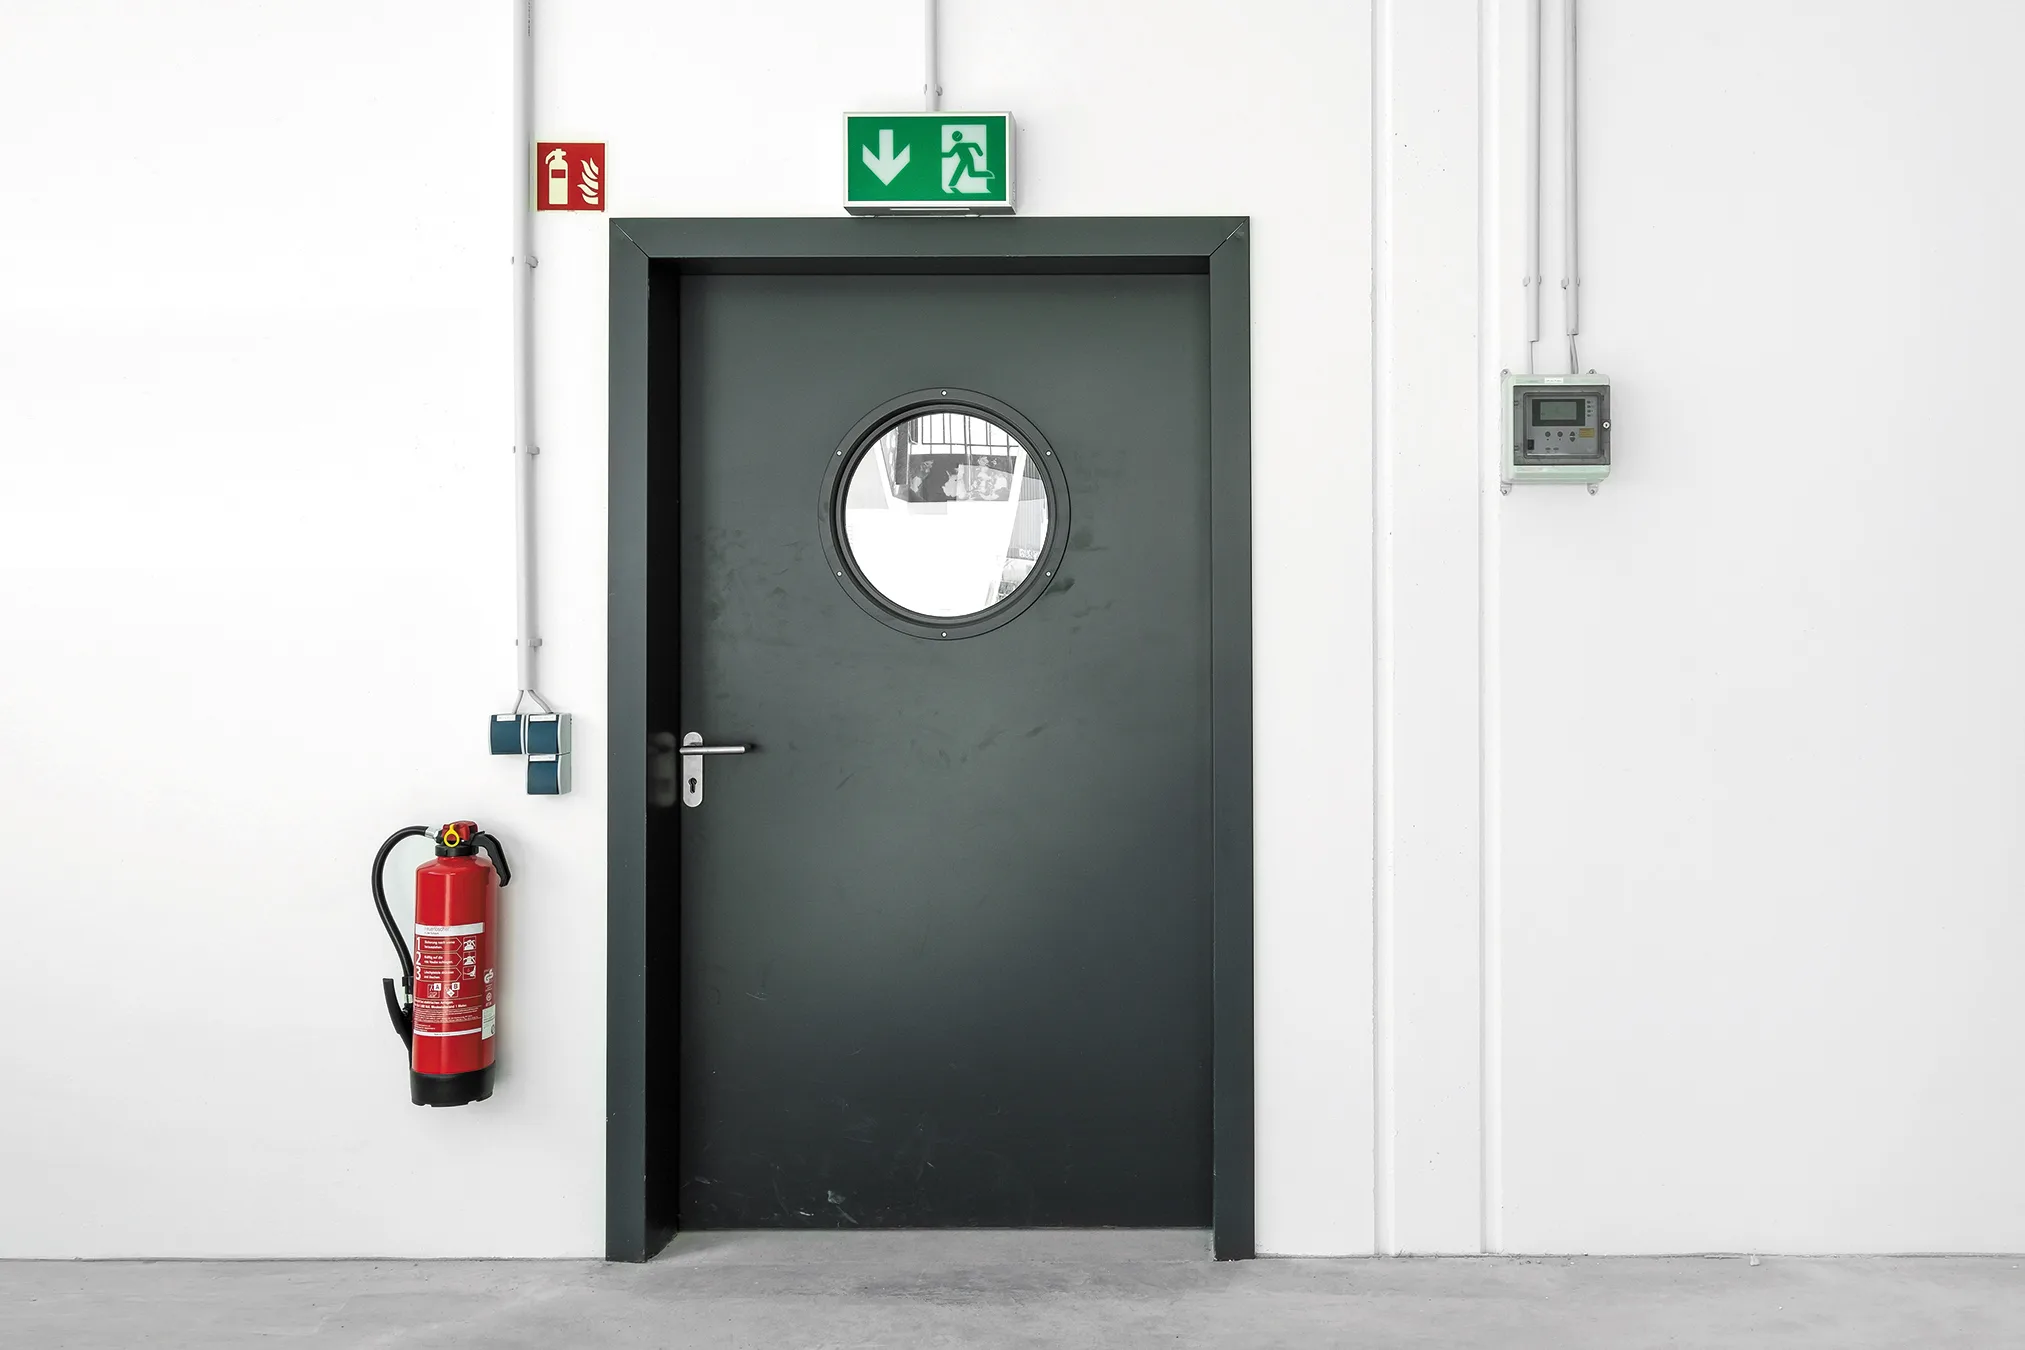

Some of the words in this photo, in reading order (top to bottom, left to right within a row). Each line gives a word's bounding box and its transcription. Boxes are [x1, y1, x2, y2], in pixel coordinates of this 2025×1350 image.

[416, 936, 421, 951] 1
[415, 951, 422, 966] 2
[415, 966, 421, 980] 3
